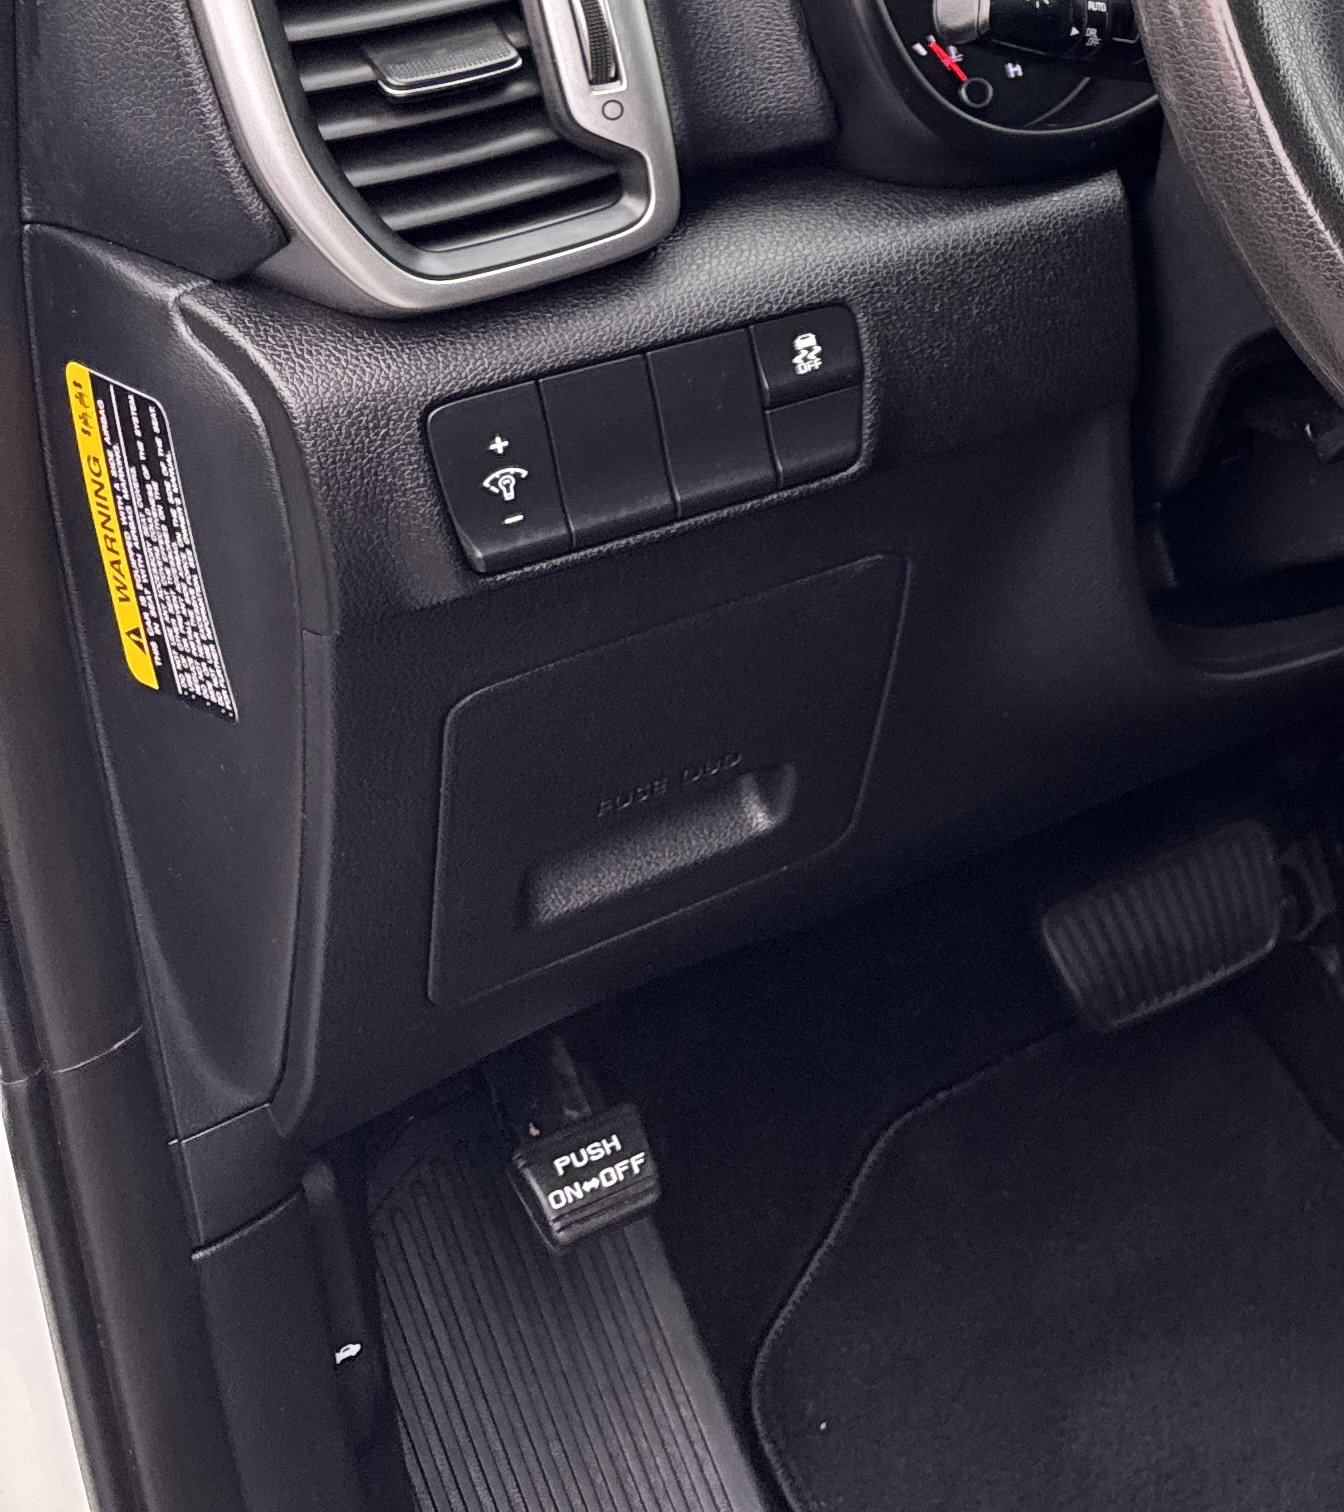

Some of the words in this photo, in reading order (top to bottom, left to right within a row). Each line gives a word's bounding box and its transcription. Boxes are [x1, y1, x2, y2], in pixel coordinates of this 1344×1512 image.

[1087, 0, 1107, 13] AUTO
[1005, 63, 1023, 79] H
[795, 358, 823, 375] OFF
[85, 452, 131, 606] WARNING
[553, 1134, 622, 1177] PUSH
